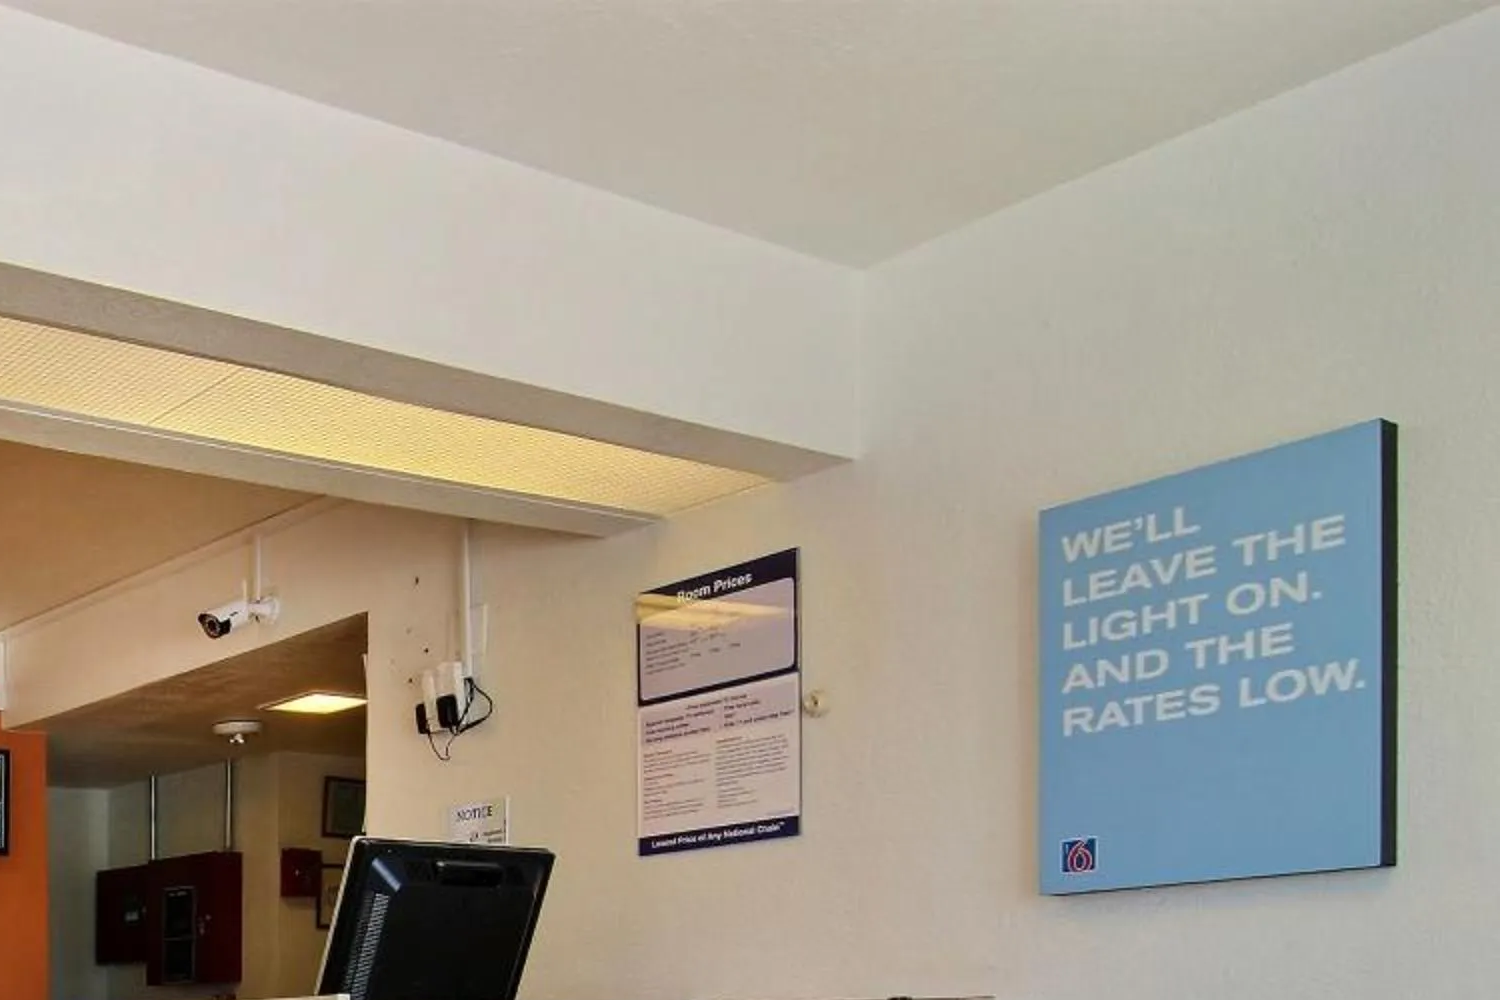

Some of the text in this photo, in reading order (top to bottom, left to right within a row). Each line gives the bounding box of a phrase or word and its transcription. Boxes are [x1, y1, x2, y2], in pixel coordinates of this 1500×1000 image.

[1061, 506, 1201, 563] WE'LL
[1063, 514, 1346, 607] LEAVE THE
[676, 572, 753, 604] Room Prices
[1063, 570, 1322, 650] LIGHT ON.
[1061, 622, 1296, 694] AND THE
[1063, 657, 1367, 737] RATES LOW.
